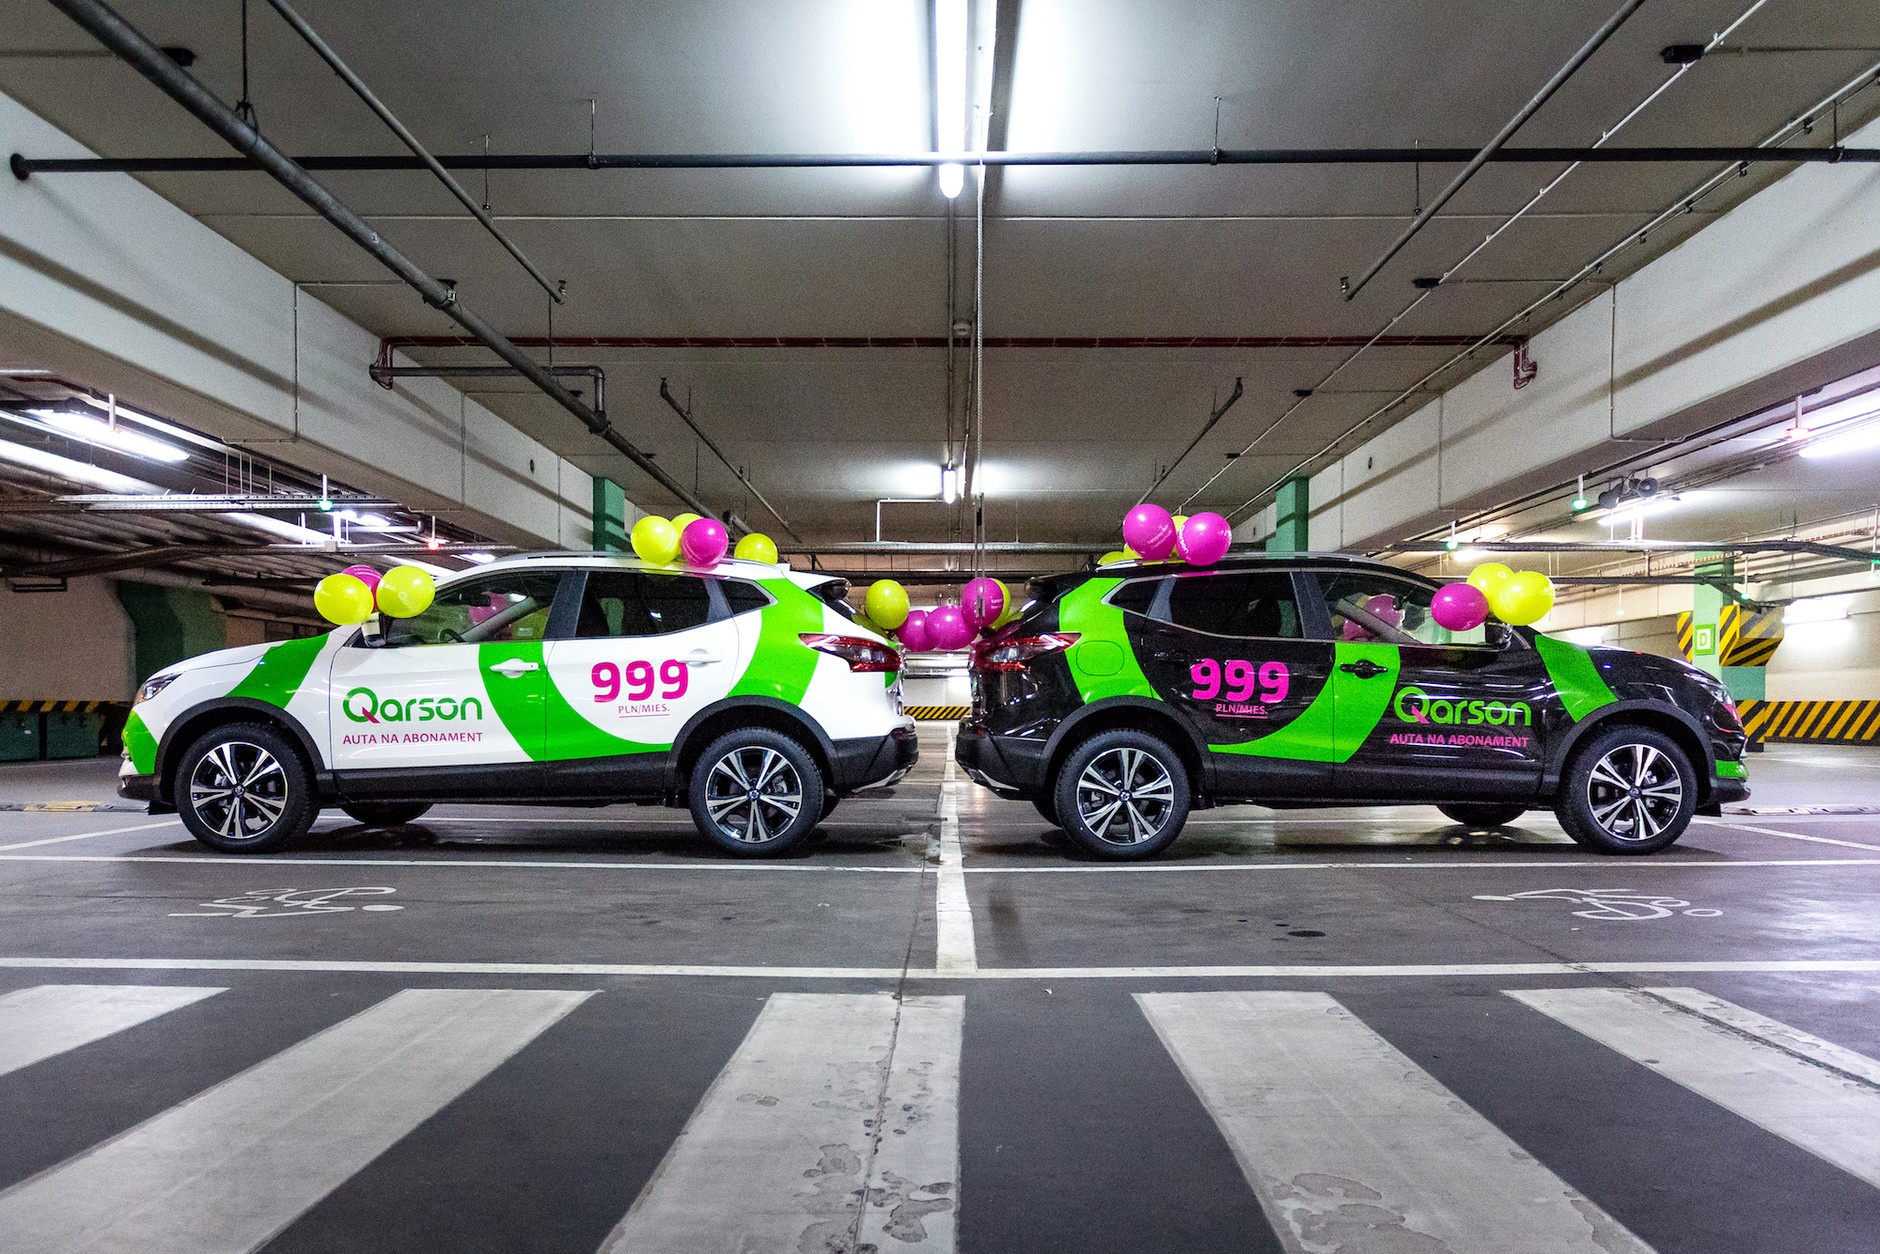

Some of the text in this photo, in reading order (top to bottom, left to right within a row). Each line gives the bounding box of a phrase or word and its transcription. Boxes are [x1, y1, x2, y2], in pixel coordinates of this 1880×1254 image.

[1699, 632, 1708, 647] D
[591, 659, 689, 703] 999
[1190, 658, 1290, 704] 999
[343, 687, 483, 724] Qarson
[618, 703, 671, 714] PLN/MIES.
[1215, 703, 1269, 715] PLN/MIES.
[1393, 686, 1532, 727] Qarson
[343, 732, 483, 745] AUTA NA ABONAMENT
[1389, 733, 1530, 748] AUTA NA ABONAMENT
